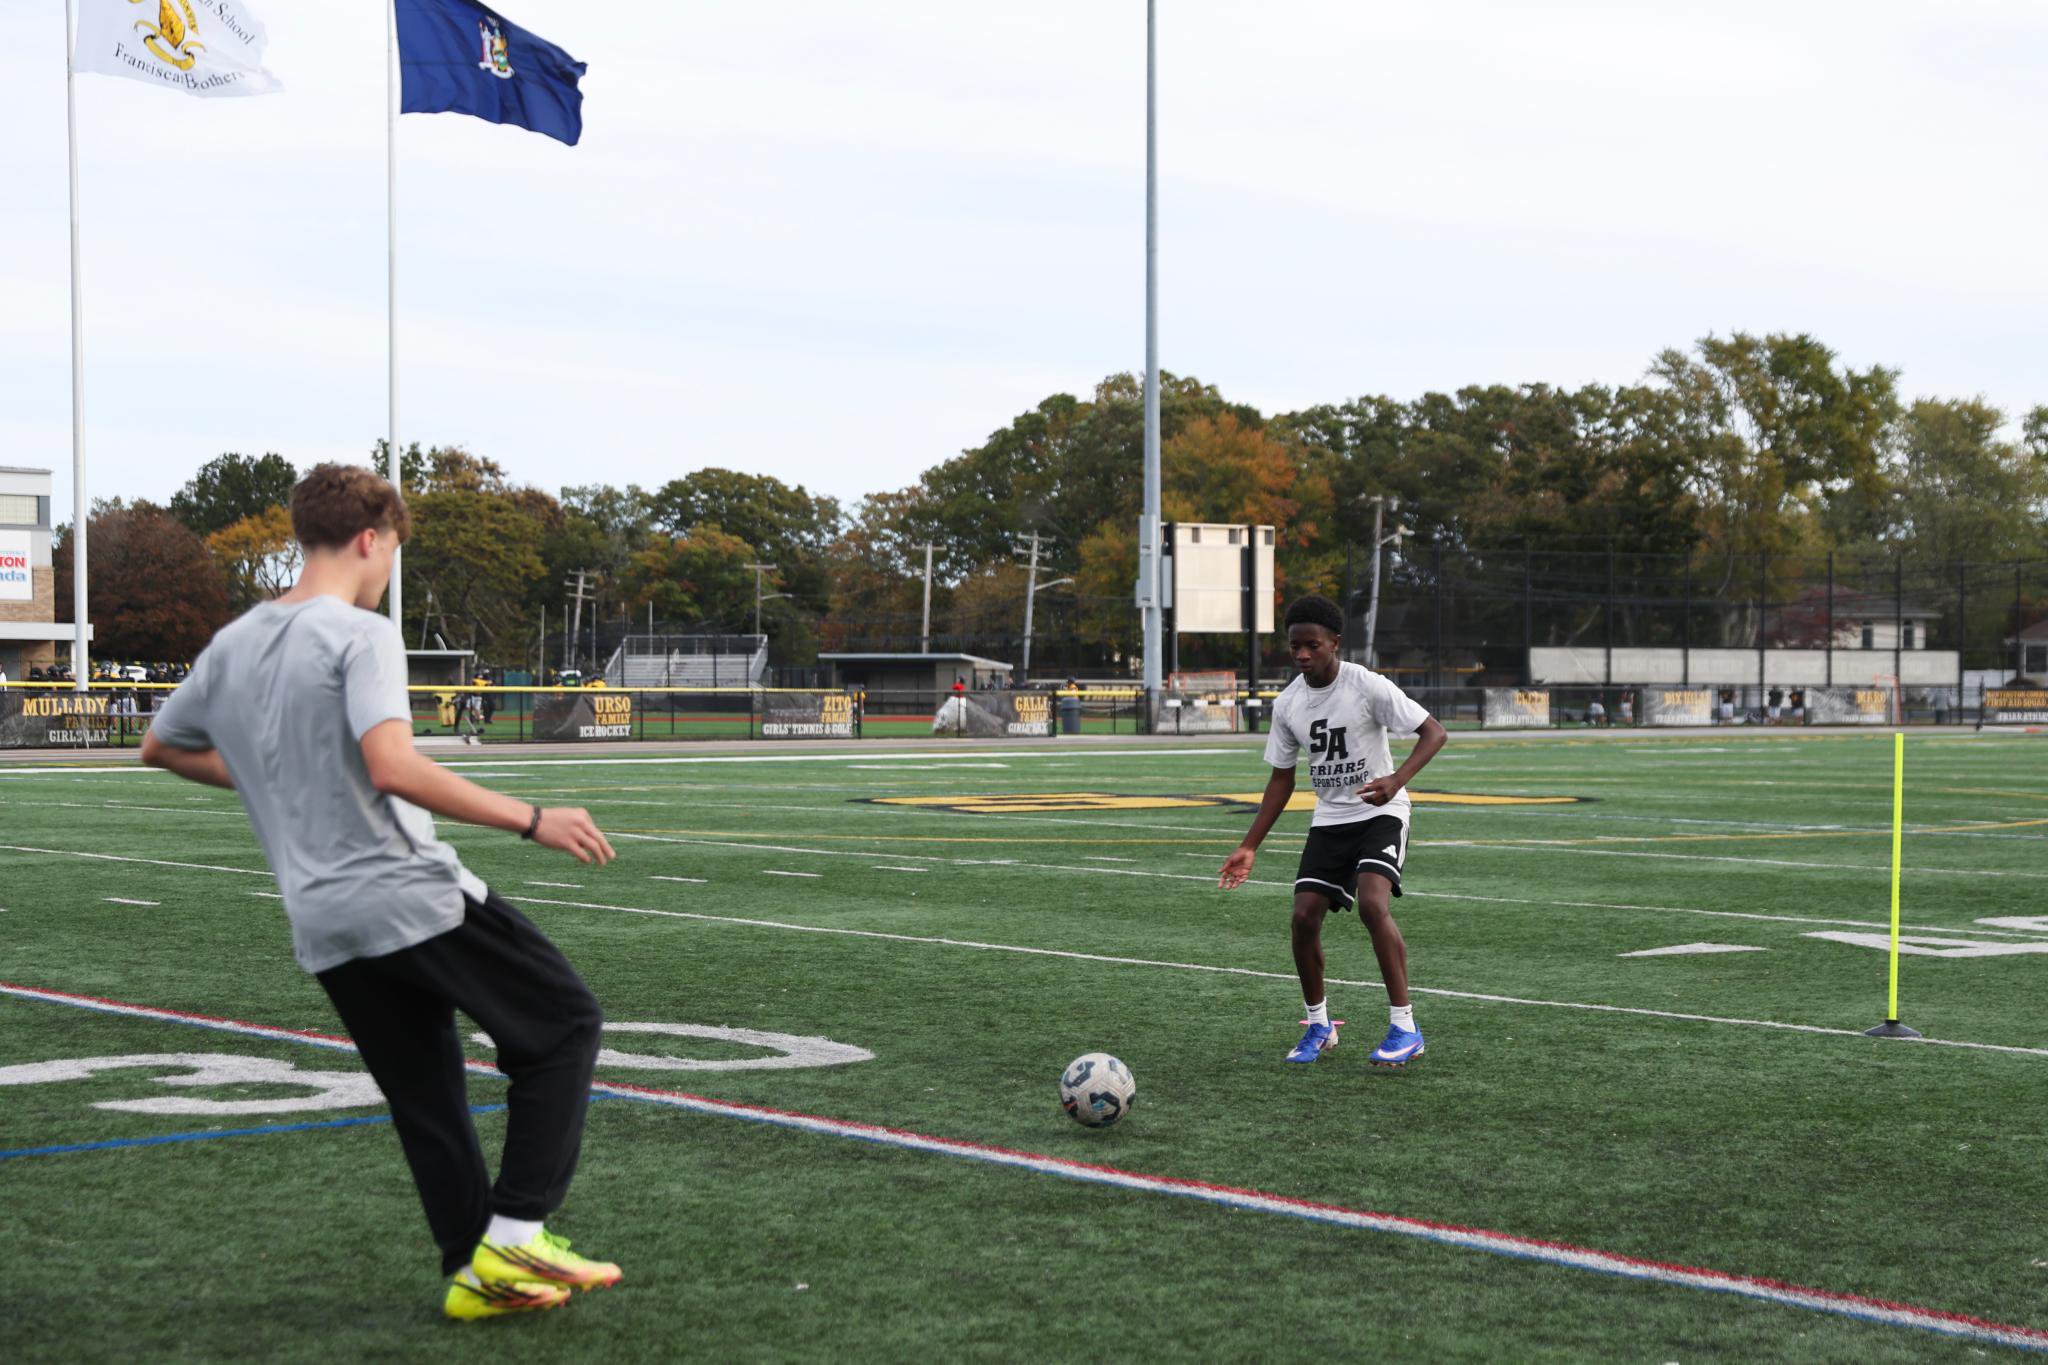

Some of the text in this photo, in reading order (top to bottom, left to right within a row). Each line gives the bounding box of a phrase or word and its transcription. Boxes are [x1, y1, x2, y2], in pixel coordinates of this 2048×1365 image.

[213, 2, 255, 45] School
[22, 697, 108, 716] MULLADY
[594, 696, 631, 713] URSO
[823, 695, 852, 711] ZITO
[1015, 696, 1048, 711] GALLI
[595, 713, 631, 725] FAMILY
[579, 725, 631, 737] ICE HOCKEY
[792, 723, 824, 735] TENNIS
[825, 724, 831, 734] &
[831, 723, 852, 734] GOLF
[1309, 718, 1349, 762] SA
[1310, 758, 1366, 776] FRIARS
[1312, 770, 1369, 788] SPORTS CAMP
